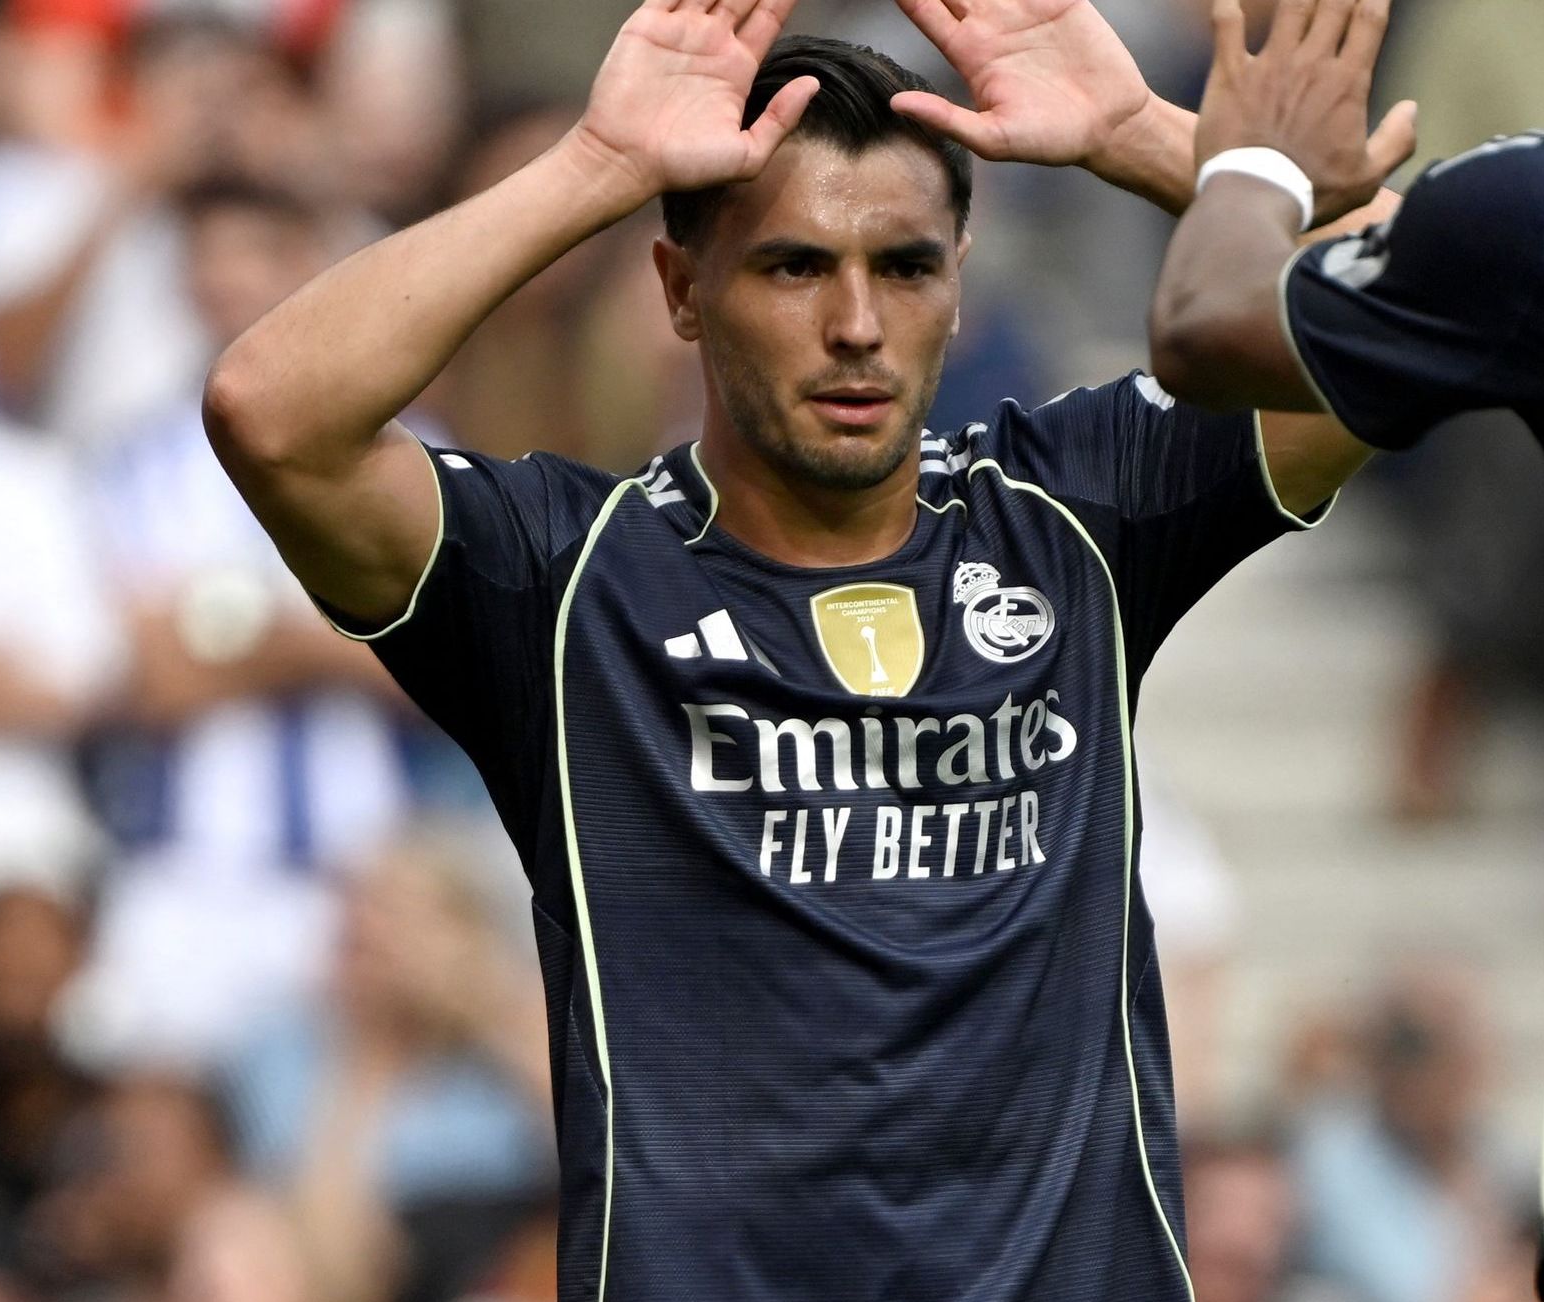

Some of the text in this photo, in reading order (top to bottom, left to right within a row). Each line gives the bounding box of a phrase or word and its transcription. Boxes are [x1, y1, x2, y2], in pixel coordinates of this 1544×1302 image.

[826, 598, 899, 609] INTERCONTINENTAL
[841, 606, 888, 617] CHAMPIONS
[681, 688, 1078, 793] Emirates
[759, 790, 1048, 885] FLY BETTER
